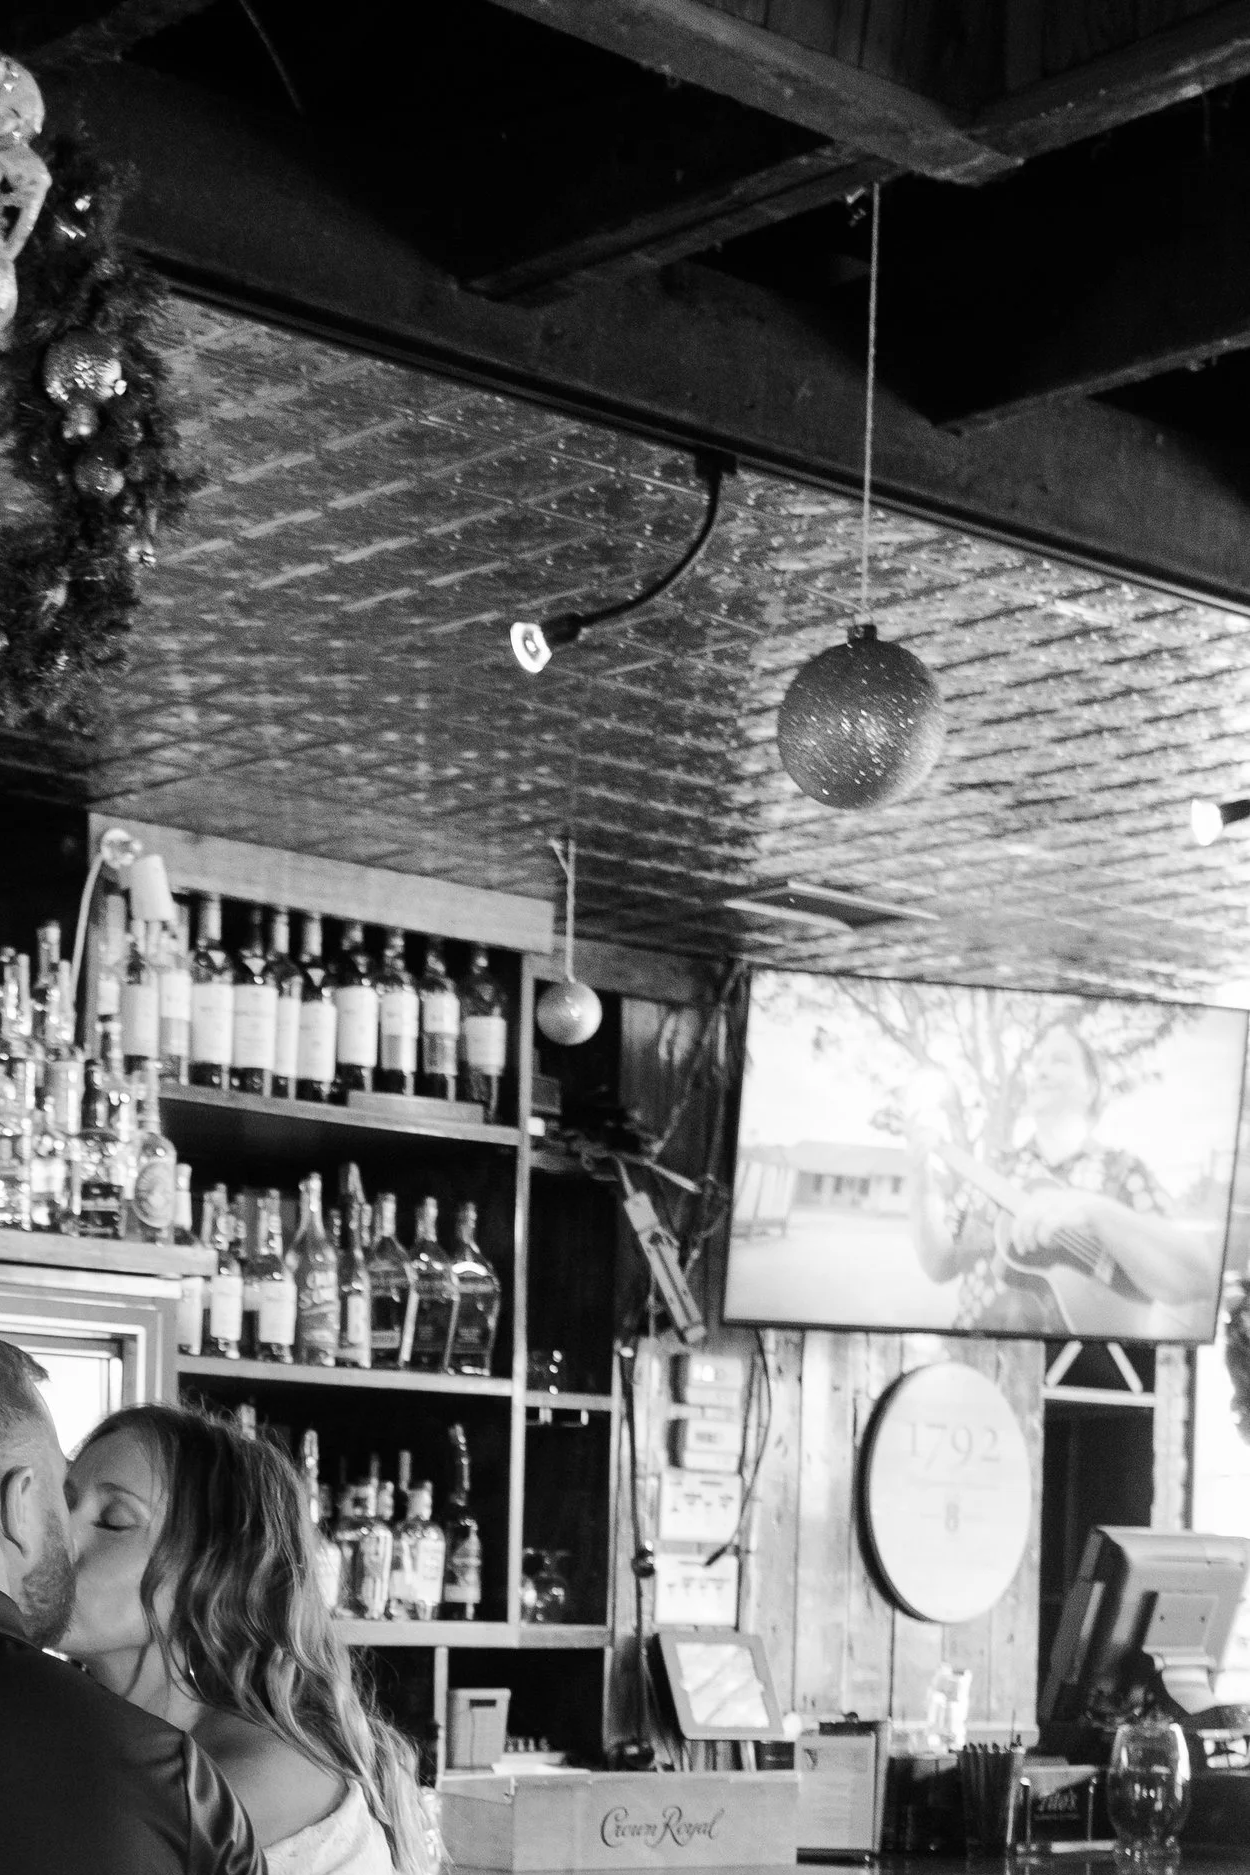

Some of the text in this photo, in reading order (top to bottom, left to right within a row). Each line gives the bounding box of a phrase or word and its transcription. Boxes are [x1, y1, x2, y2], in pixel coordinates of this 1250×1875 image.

[906, 1420, 1002, 1472] 1792
[600, 1804, 725, 1848] Crown Royal
